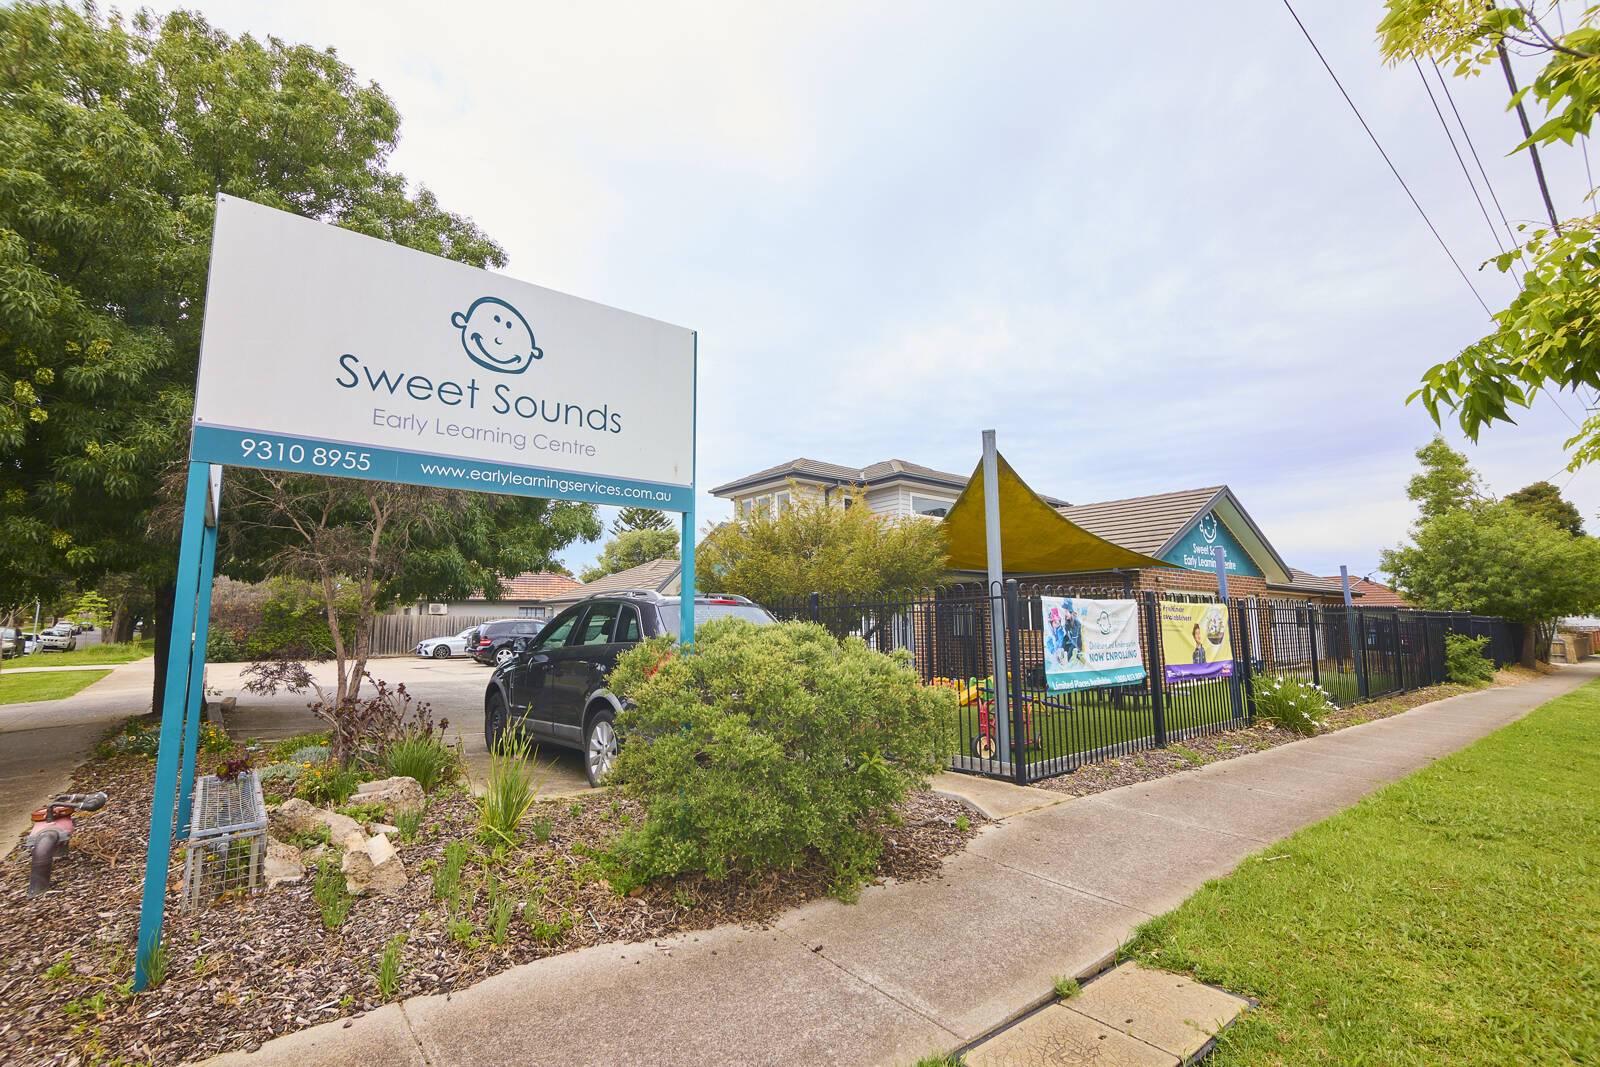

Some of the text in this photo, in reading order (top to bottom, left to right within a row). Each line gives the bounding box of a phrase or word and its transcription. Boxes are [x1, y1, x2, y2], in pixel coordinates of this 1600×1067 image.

[336, 353, 622, 433] Sweet Sounds
[373, 408, 596, 457] Early Learning Centre
[240, 438, 371, 471] 9310 8955
[420, 463, 672, 502] www.earlylearningservices.com.au
[1192, 543, 1209, 554] Sweet
[1183, 554, 1197, 568] Early
[1198, 556, 1217, 568] Learnin
[1088, 649, 1138, 662] NOW ENROLLING
[1052, 679, 1074, 690] Limited
[1074, 678, 1091, 688] Places
